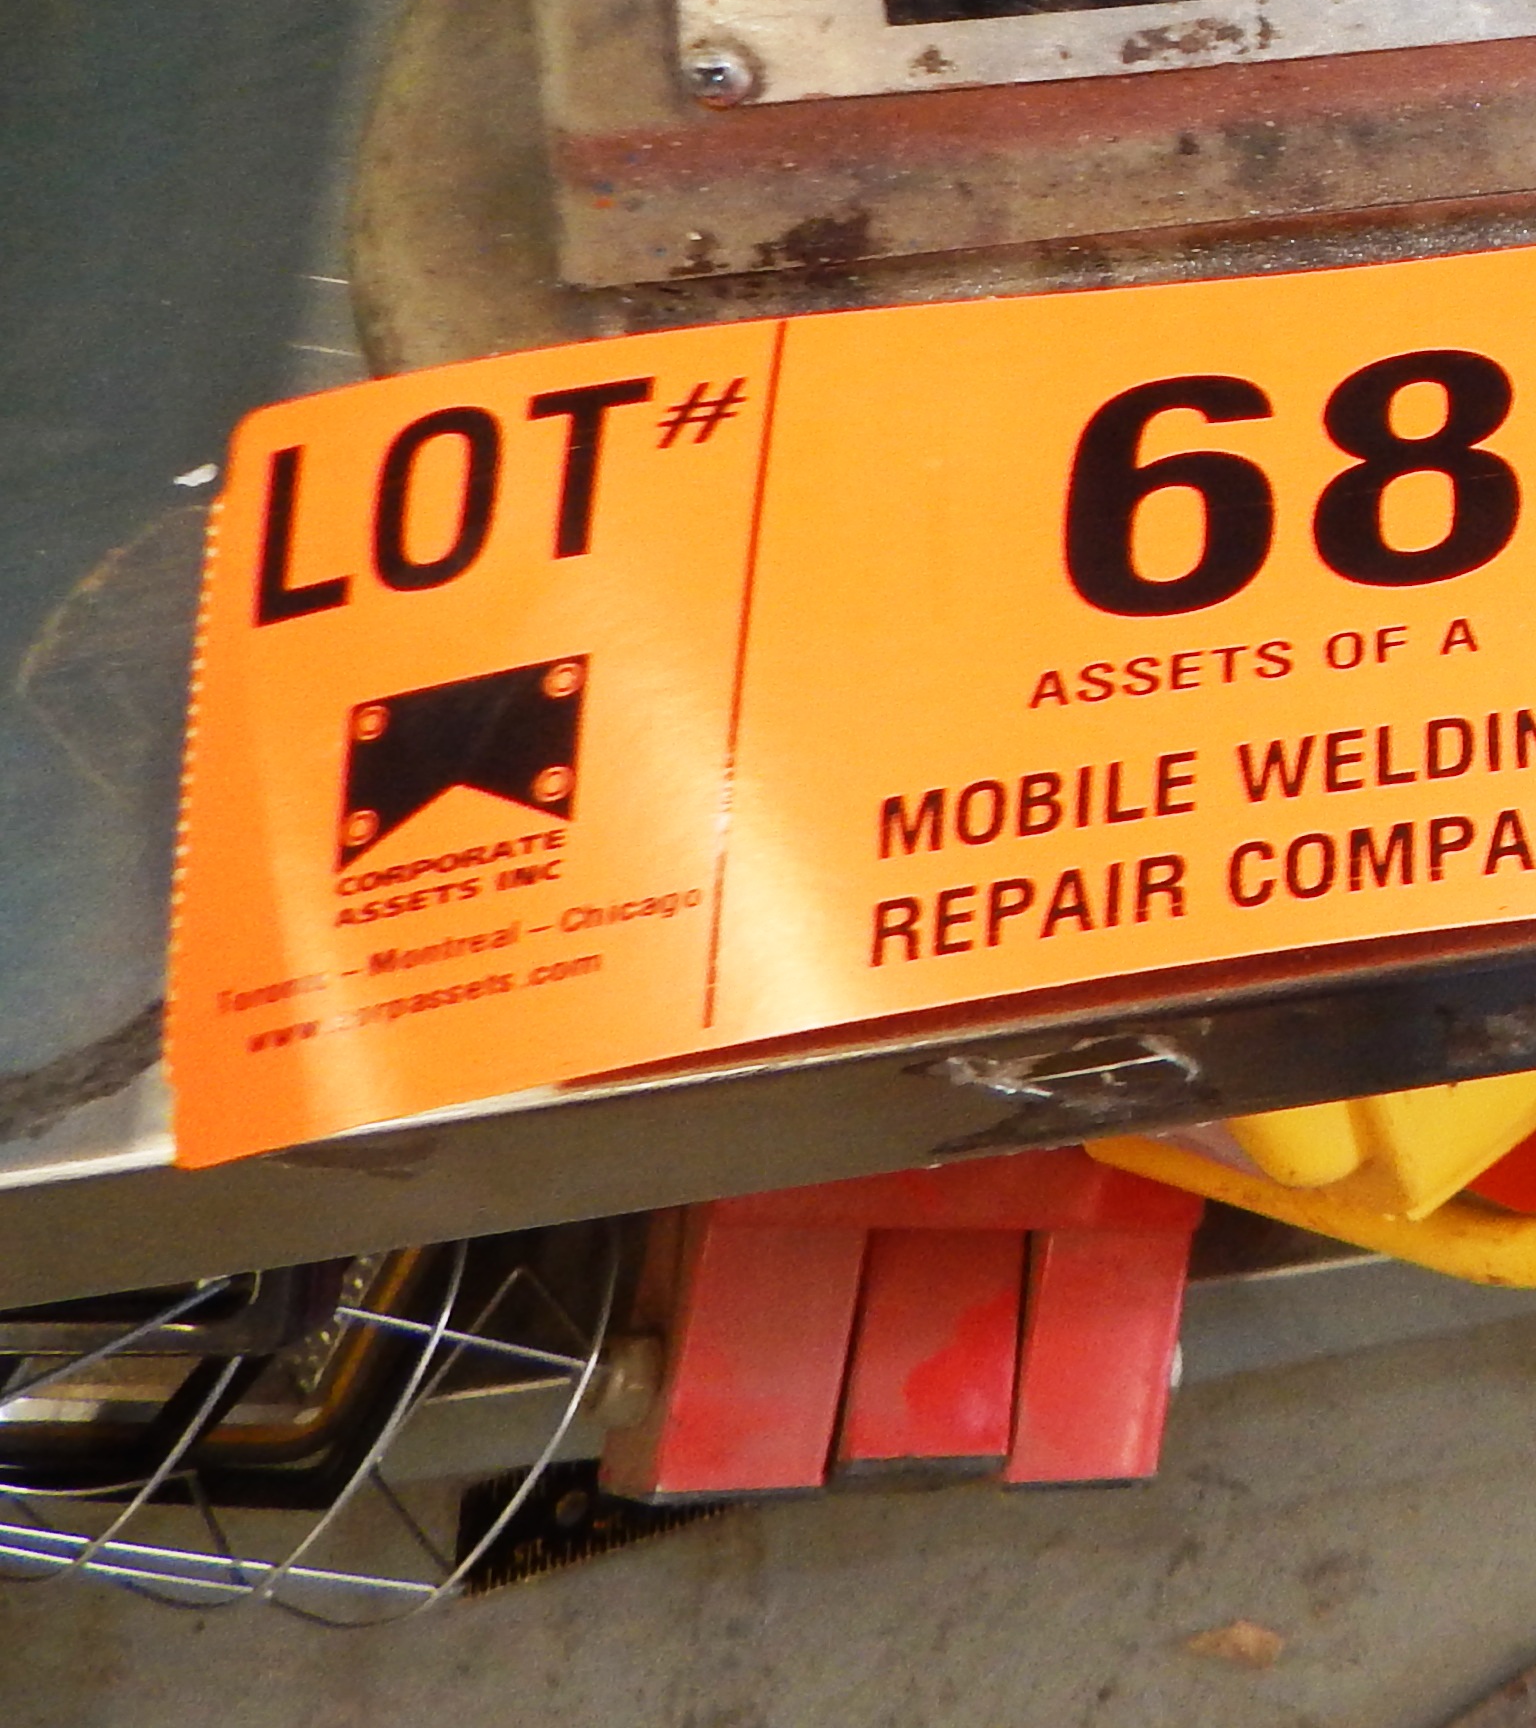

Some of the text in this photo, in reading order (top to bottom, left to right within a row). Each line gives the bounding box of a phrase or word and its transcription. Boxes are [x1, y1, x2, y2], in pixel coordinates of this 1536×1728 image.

[1062, 347, 1525, 619] 68
[1028, 616, 1482, 710] ASSETS OF A
[877, 746, 1198, 861] MOBILE
[333, 859, 562, 929] ASSETS INC
[334, 828, 567, 897] CORPORATE
[368, 921, 520, 975] Montreal
[558, 887, 703, 934] Chicago
[867, 855, 1192, 969] REPAIR
